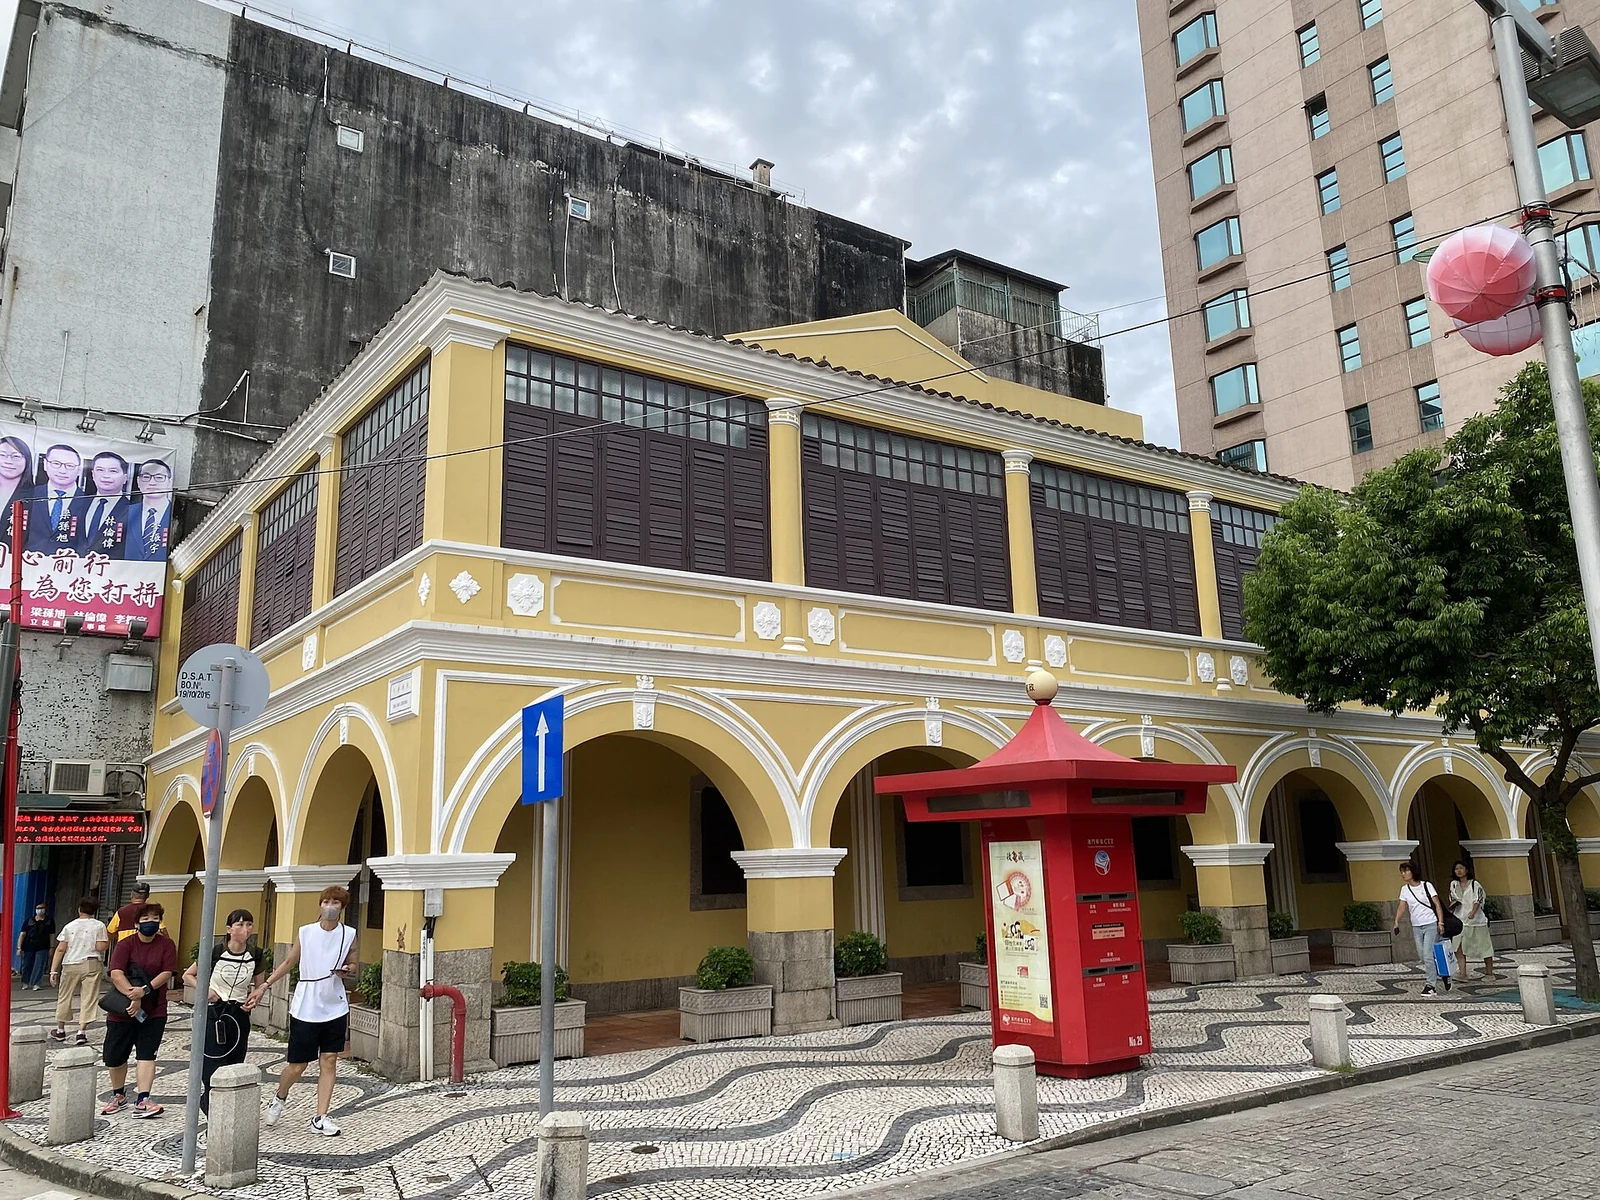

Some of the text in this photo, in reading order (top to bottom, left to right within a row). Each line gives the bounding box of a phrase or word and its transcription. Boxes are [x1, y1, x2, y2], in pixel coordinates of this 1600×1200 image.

[31, 573, 160, 608] 為您打拼
[181, 671, 214, 681] D.S.A.T.
